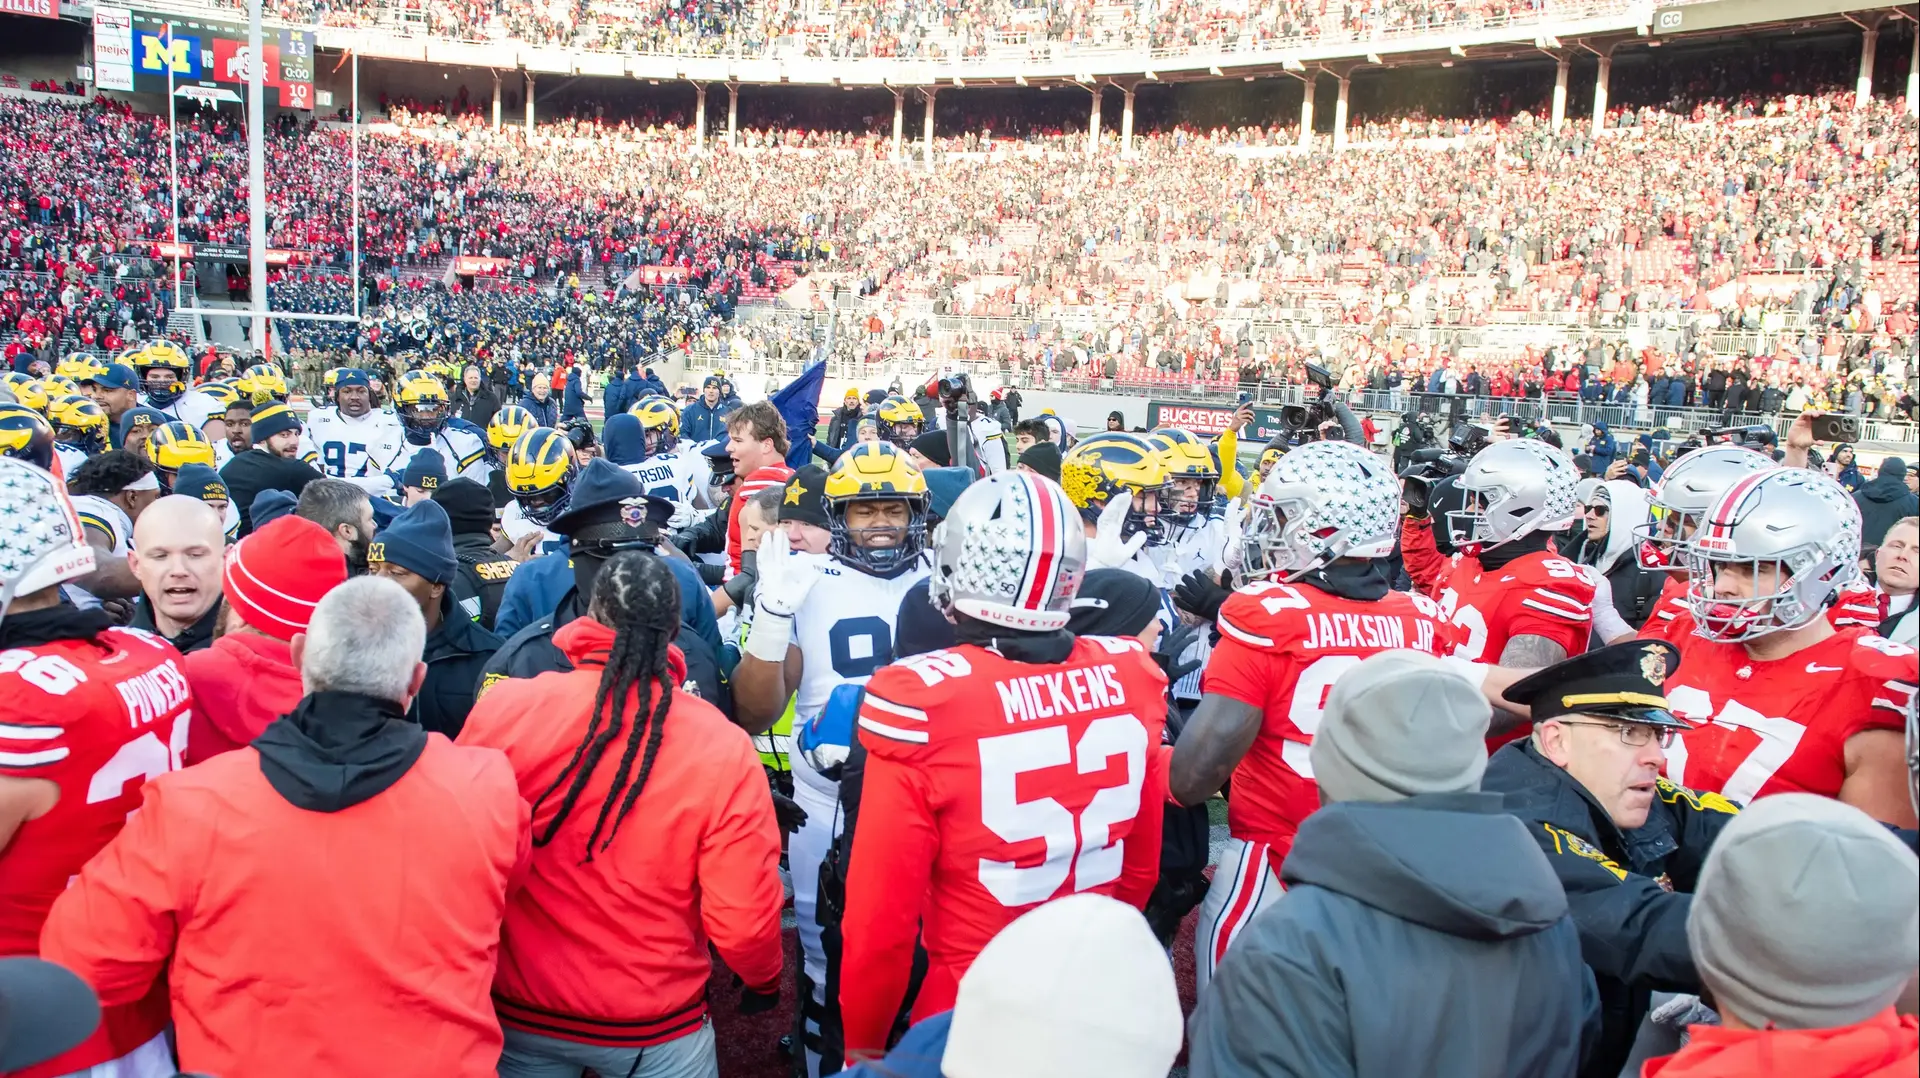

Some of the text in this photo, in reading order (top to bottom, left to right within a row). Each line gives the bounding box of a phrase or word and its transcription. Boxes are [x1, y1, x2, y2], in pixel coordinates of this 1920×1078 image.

[0, 0, 51, 15] ILLIS
[1663, 14, 1680, 25] CC
[97, 44, 129, 56] meijer
[141, 35, 191, 73] M
[289, 42, 306, 55] 13
[201, 50, 214, 68] VS
[285, 67, 309, 79] 0:00
[290, 84, 307, 97] 10
[134, 414, 152, 425] M
[1159, 408, 1233, 426] BUCKEYES
[1266, 415, 1280, 424] The
[323, 440, 370, 478] 97
[421, 476, 437, 488] M
[632, 465, 674, 484] RSON
[368, 542, 386, 562] M
[980, 609, 1065, 627] BUCKEYES
[1303, 612, 1405, 650] JACKSON
[1411, 618, 1435, 653] JR
[115, 659, 190, 729] POWERS
[995, 663, 1127, 724] MICKENS
[977, 713, 1149, 908] 52
